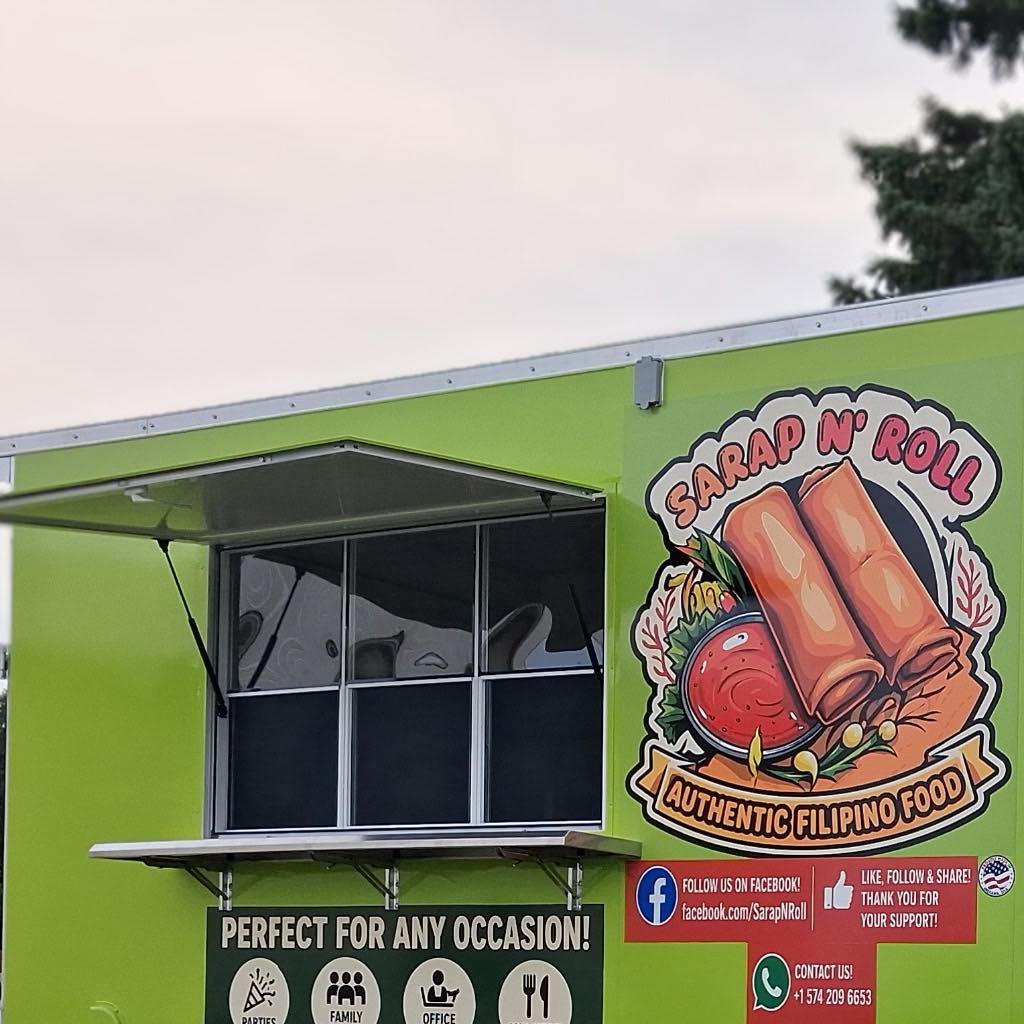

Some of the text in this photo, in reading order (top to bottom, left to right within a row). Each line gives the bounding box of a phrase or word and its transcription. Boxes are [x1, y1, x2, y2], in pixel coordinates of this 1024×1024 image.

[664, 408, 983, 530] SARAP N' ROLL
[665, 770, 964, 836] AUTHENTIC FILIPINO FOOD
[682, 876, 800, 893] FOLLOW US ON FACEBOOK!
[861, 868, 971, 886] LIKE, FOLLOW & SHARE!
[861, 890, 939, 906] THANK YOU FOR
[682, 901, 807, 924] facebook.com/SarapNRoll
[861, 912, 938, 928] YOUR SUPPORT!
[221, 915, 591, 951] PERFECT FOR ANY OCCASION!
[794, 964, 853, 980] CONTACT US!
[793, 988, 872, 1006] +1 574 209 6653
[330, 1010, 363, 1023] FAMILY
